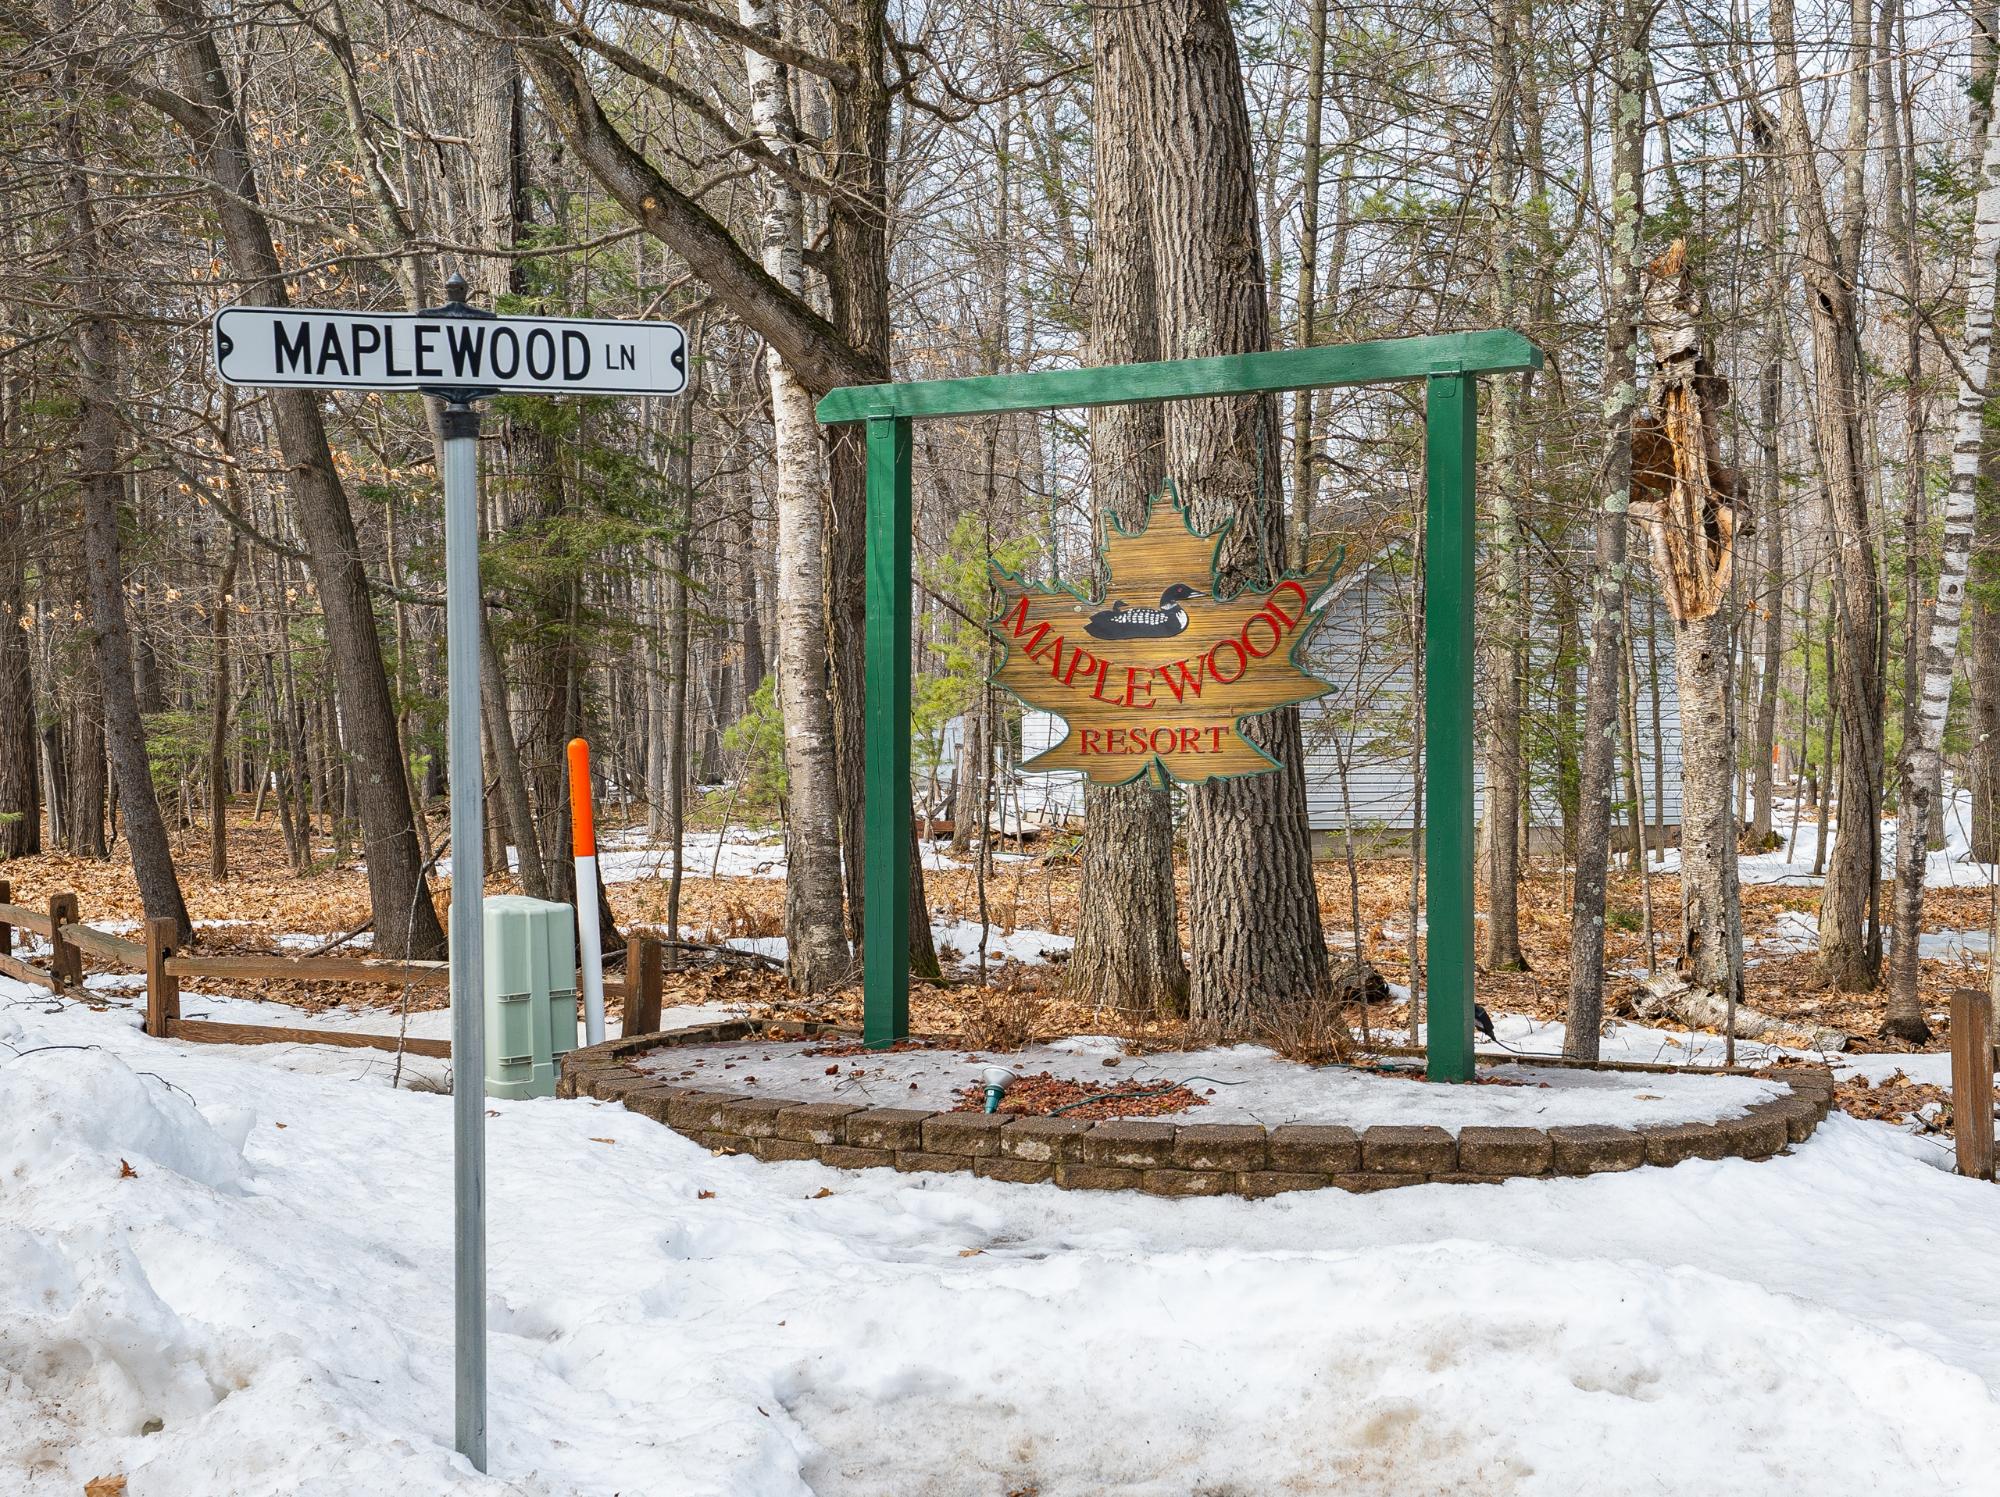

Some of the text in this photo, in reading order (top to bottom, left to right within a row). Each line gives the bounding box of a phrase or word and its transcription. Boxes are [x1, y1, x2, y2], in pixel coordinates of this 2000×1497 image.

[273, 320, 636, 381] MAPLEWOOD LN
[1001, 580, 1309, 710] MAPLEWOOD
[1078, 725, 1230, 756] RESORT
